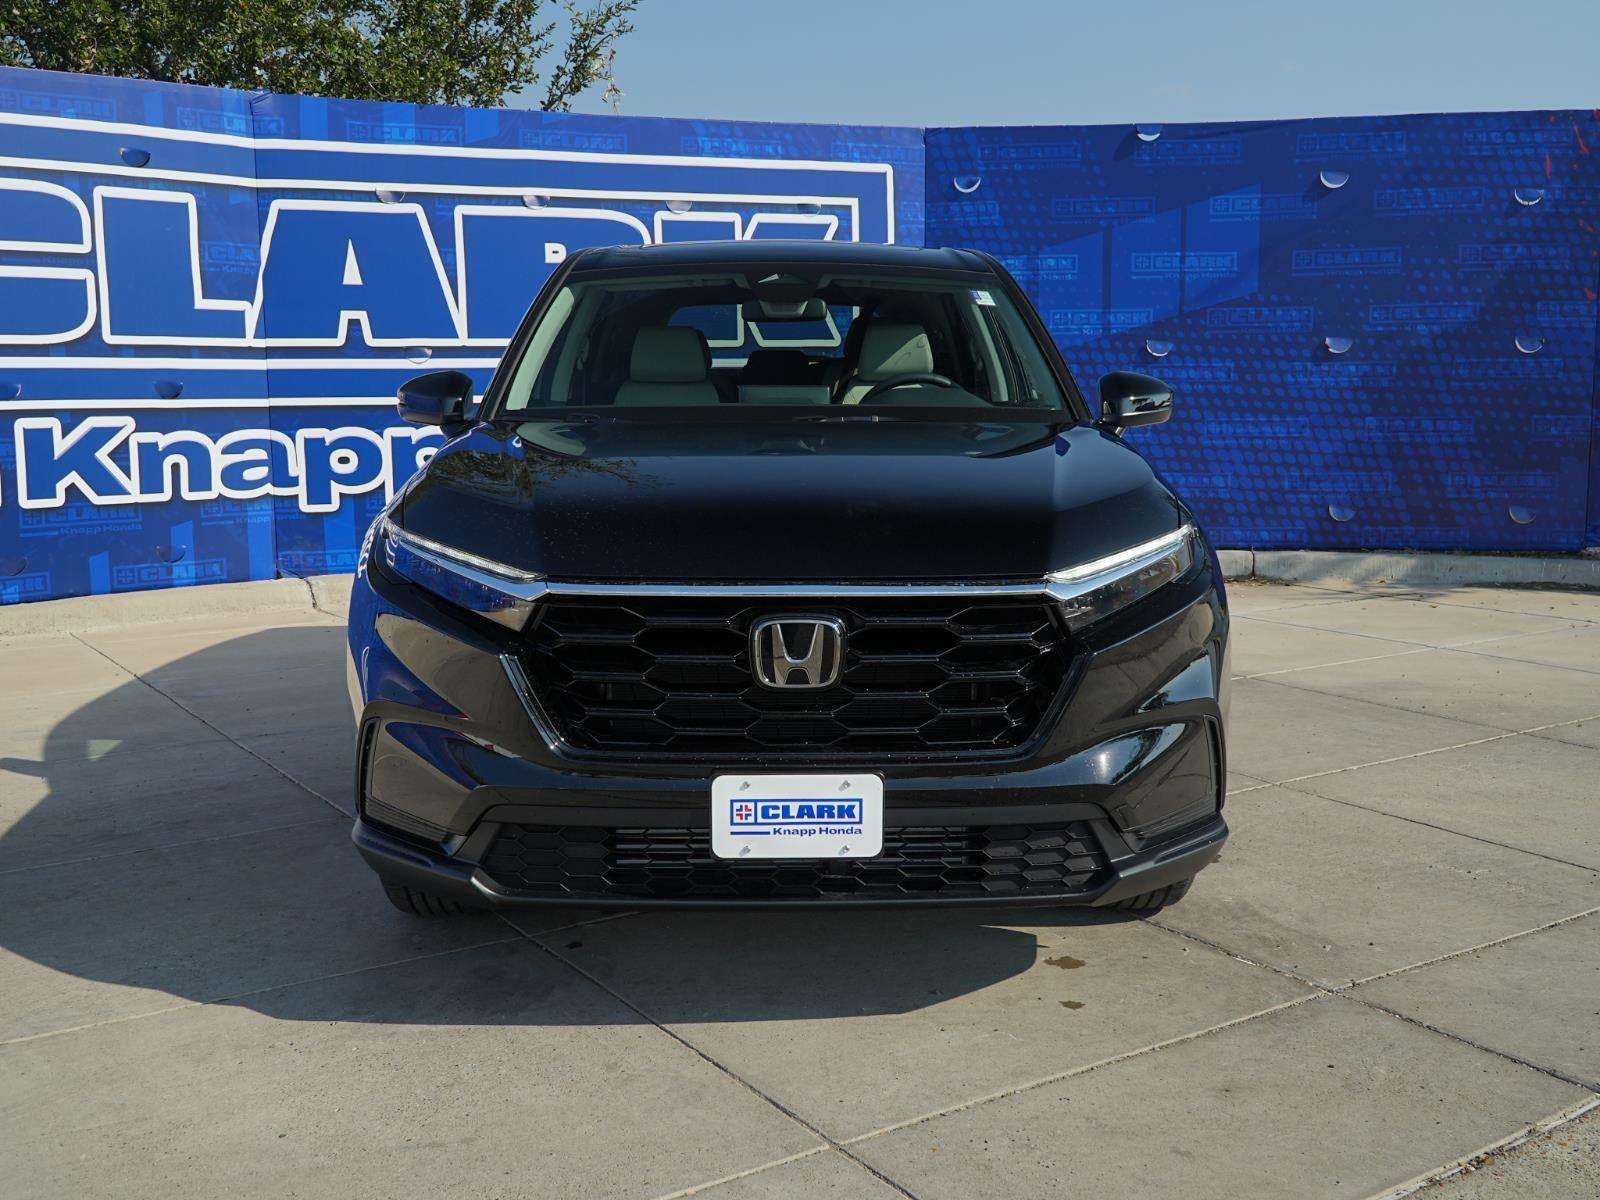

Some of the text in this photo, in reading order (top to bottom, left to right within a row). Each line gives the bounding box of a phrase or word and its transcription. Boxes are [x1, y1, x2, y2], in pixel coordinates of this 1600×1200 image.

[210, 246, 259, 262] CLA
[761, 804, 857, 820] CLARK
[773, 826, 862, 837] Knapp Honda
